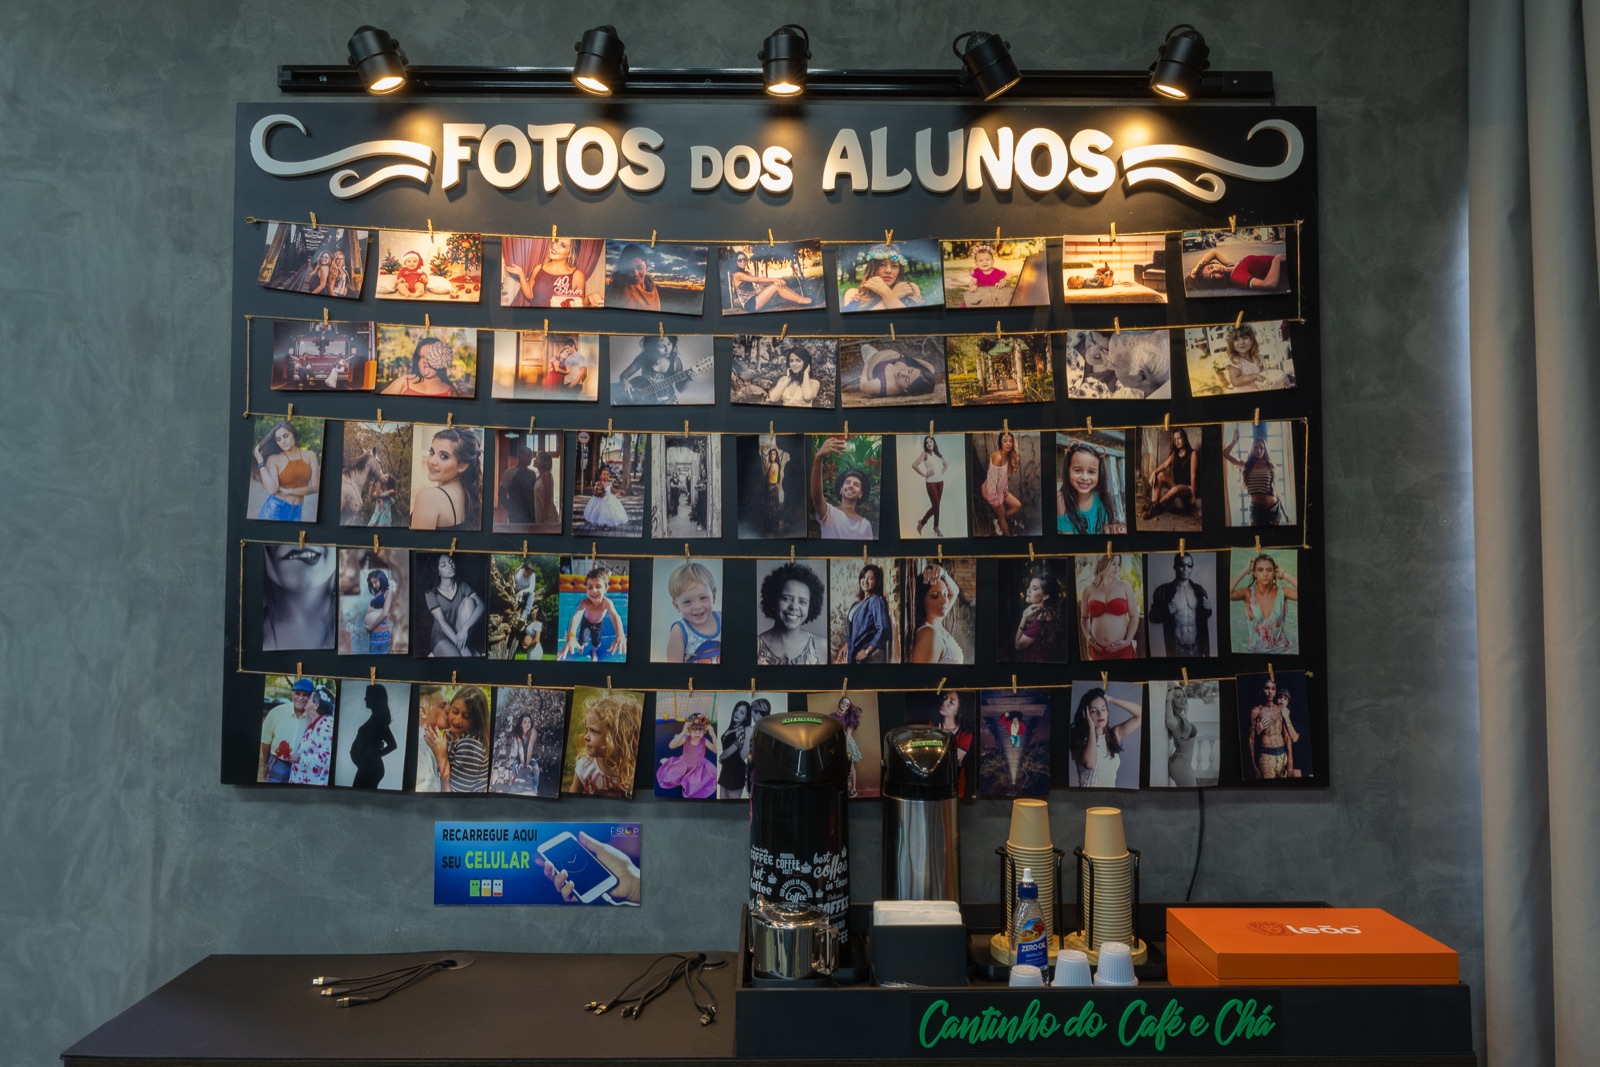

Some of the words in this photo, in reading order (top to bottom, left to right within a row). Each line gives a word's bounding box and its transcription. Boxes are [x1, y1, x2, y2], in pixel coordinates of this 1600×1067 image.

[442, 121, 666, 194] FOTOS
[690, 144, 793, 194] DOS
[822, 126, 1117, 194] ALUNOS
[553, 275, 570, 287] 40
[442, 828, 509, 842] RECARREGUE
[513, 829, 538, 842] AQUI
[442, 855, 461, 869] SEU
[464, 850, 530, 869] CELULAR
[775, 858, 801, 870] COFFEE
[813, 850, 832, 865] best
[752, 865, 766, 881] hot
[813, 854, 848, 880] coffee
[785, 891, 807, 903] Coffee
[1286, 924, 1362, 935] leão
[919, 999, 1061, 1049] Cantinho
[1063, 1000, 1107, 1038] do
[1118, 998, 1186, 1052] Café
[1189, 1014, 1209, 1037] e
[1214, 998, 1276, 1046] Chá
